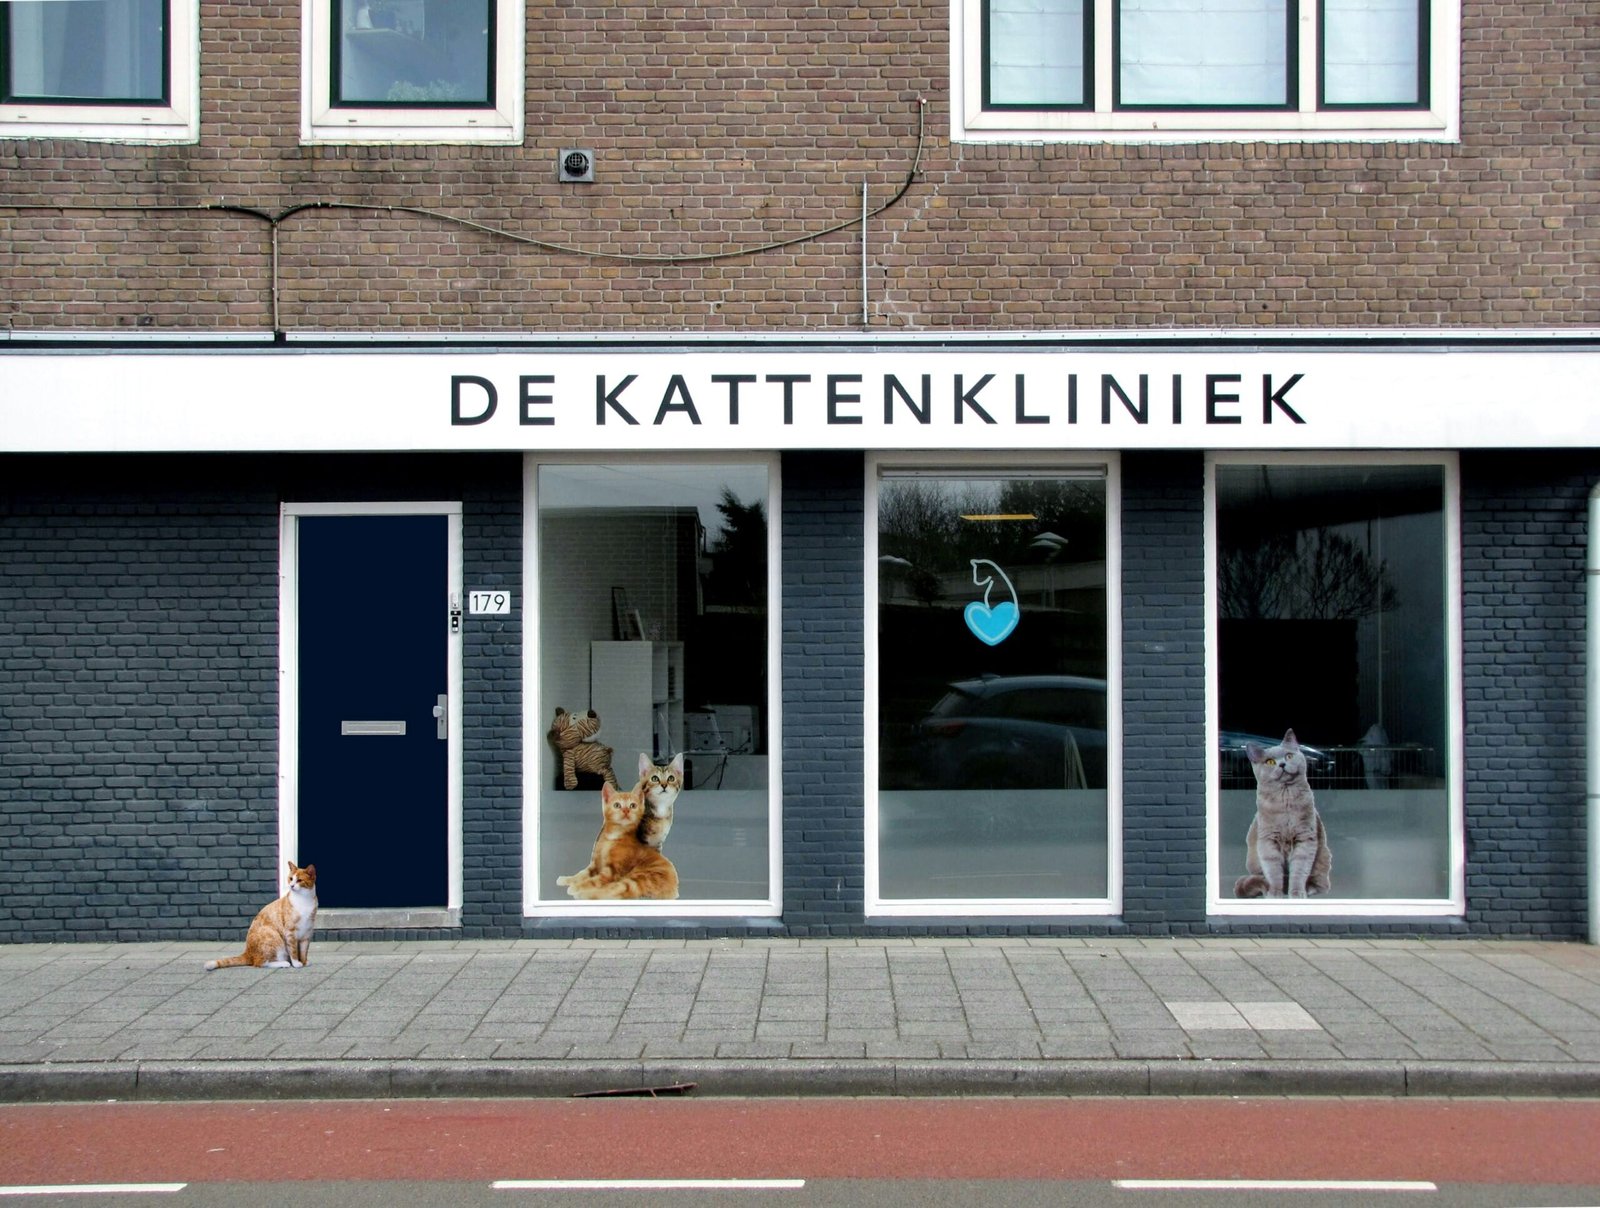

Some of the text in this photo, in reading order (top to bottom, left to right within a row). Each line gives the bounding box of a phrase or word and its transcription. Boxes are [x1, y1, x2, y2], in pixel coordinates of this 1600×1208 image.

[451, 373, 1306, 426] DE KATTENKLINIEK
[473, 594, 505, 612] 179
